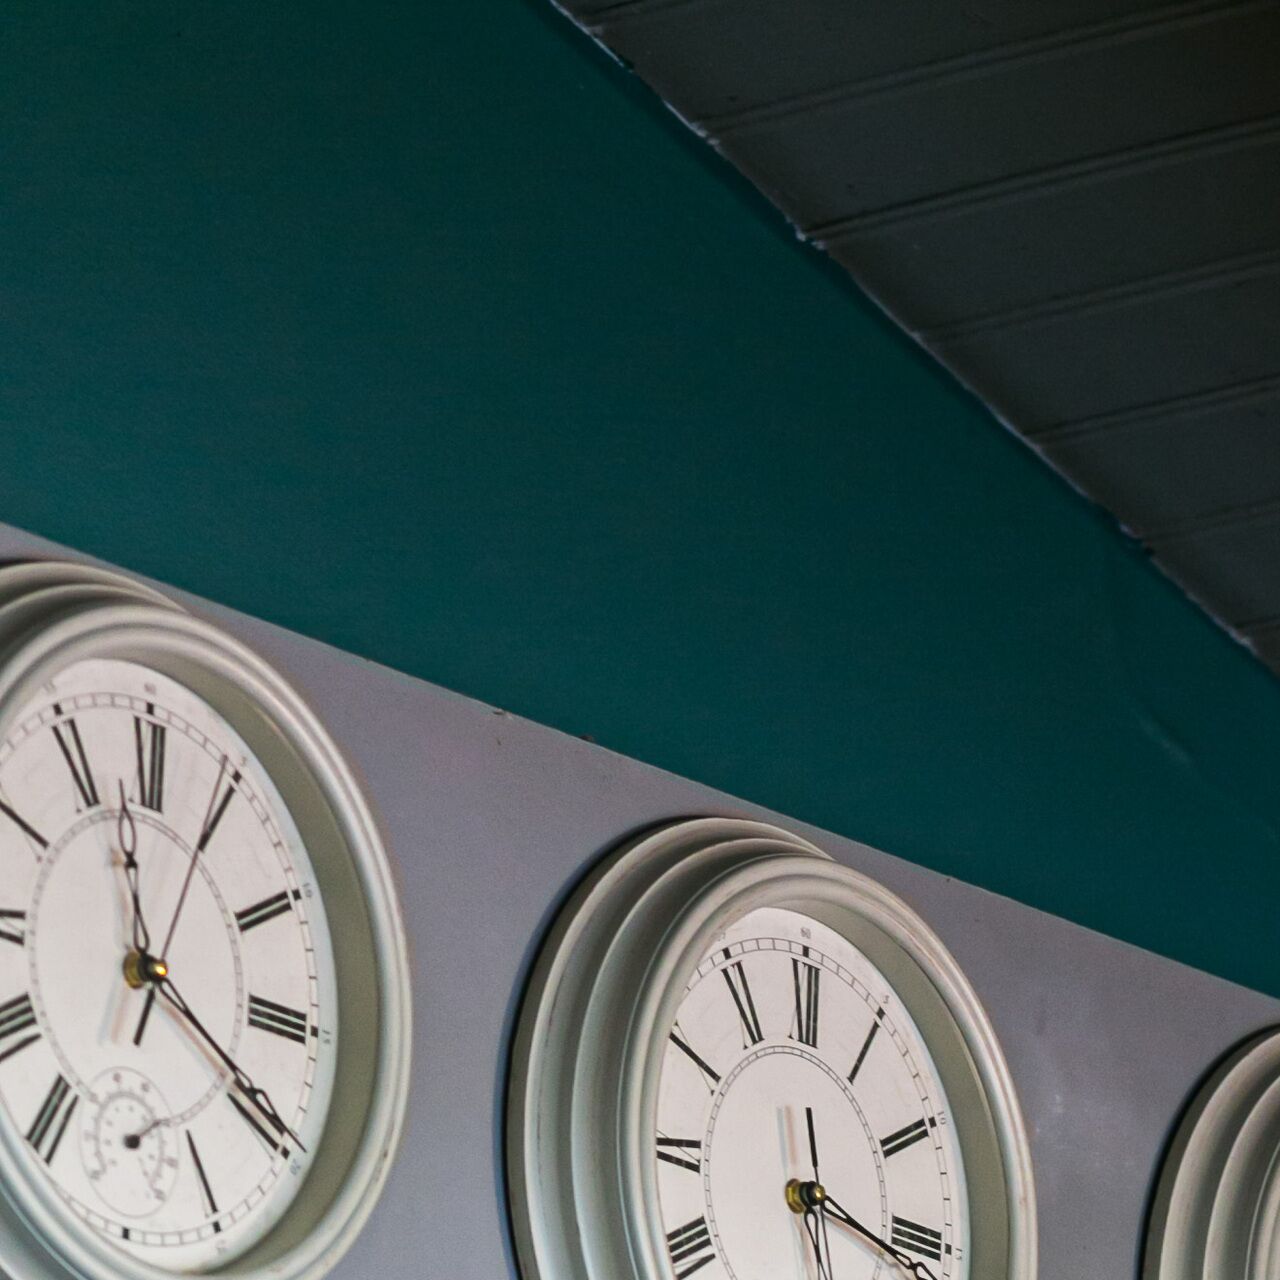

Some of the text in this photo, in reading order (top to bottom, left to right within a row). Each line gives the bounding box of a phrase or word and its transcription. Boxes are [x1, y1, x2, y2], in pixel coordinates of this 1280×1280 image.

[52, 718, 101, 813] XI
[128, 715, 166, 814] XII
[235, 891, 292, 932] II
[249, 993, 307, 1045] III
[721, 960, 764, 1050] XI
[788, 957, 821, 1048] XII
[26, 1074, 79, 1164] VII
[879, 1117, 929, 1159] II
[891, 1212, 942, 1261] III
